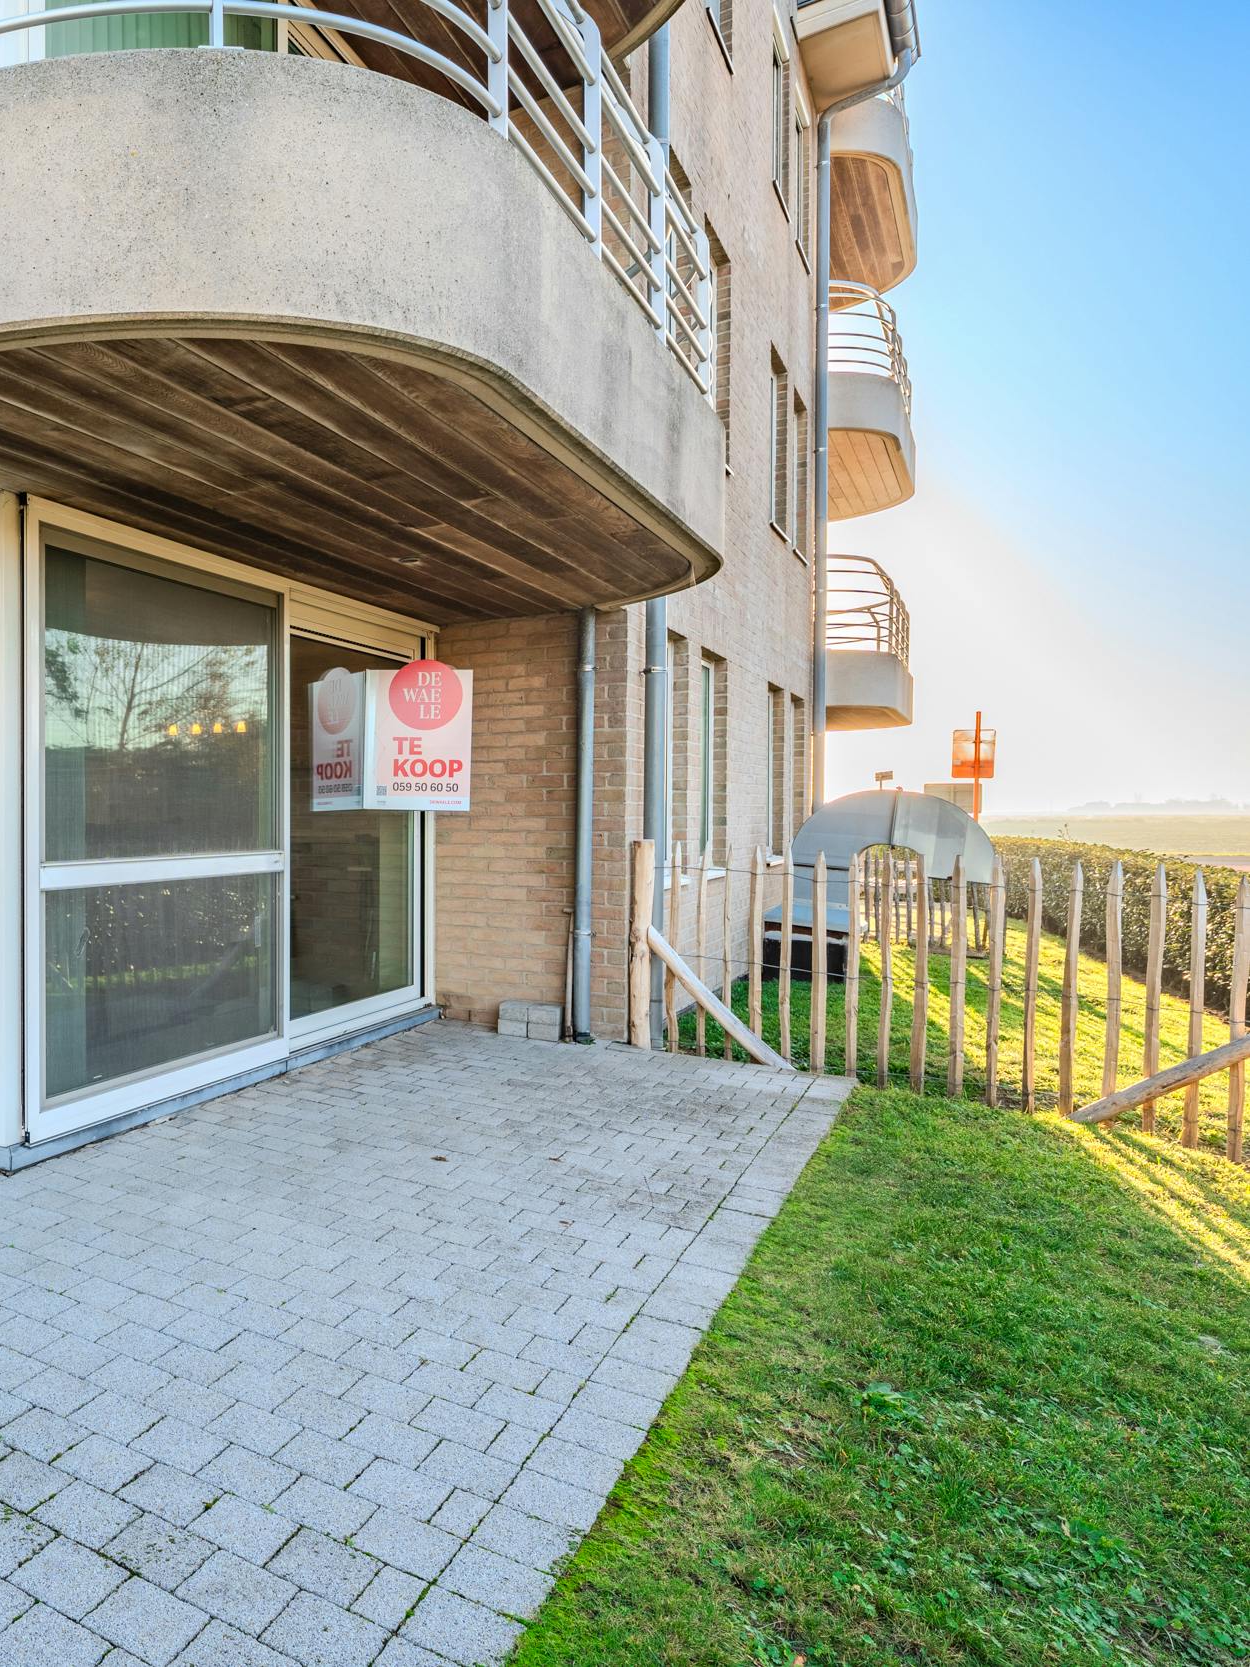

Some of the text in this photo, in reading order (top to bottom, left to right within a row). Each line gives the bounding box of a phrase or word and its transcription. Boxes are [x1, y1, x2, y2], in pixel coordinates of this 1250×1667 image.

[417, 671, 442, 687] DE
[403, 687, 442, 703] WAE
[419, 704, 441, 720] LE
[392, 736, 423, 756] TE
[392, 758, 463, 778] KOOP
[392, 782, 459, 793] 059 50 60 50
